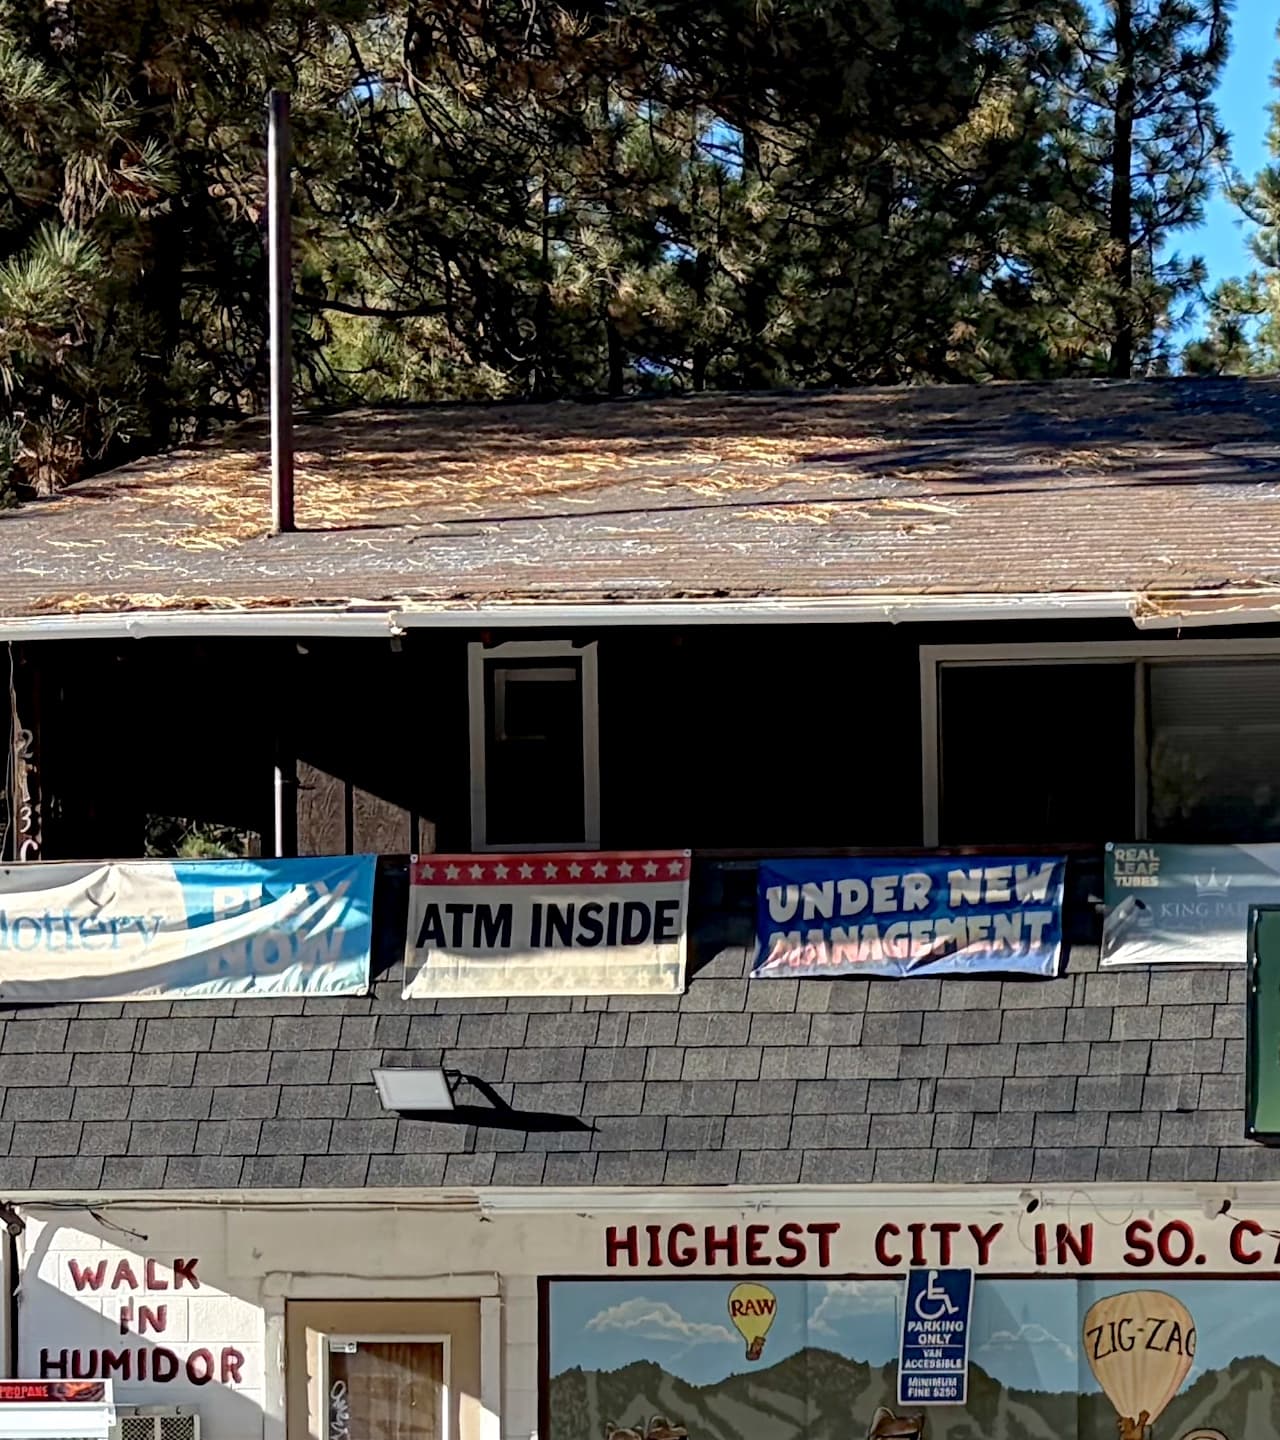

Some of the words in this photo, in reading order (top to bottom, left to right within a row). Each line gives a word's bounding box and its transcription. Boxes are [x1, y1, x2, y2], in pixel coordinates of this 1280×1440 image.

[1115, 848, 1160, 862] REAL
[1114, 863, 1160, 875] LEAF
[1114, 876, 1160, 887] TUBES
[766, 873, 932, 923] UNDER
[948, 862, 1057, 907] NEW
[1161, 902, 1209, 918] KING
[415, 903, 513, 950] ATM
[530, 900, 681, 949] INSIDE
[769, 911, 1053, 967] MANAGEMENT
[206, 927, 346, 974] NOW
[604, 1222, 841, 1268] HIGHEST
[874, 1222, 1004, 1267] CITY
[1034, 1222, 1095, 1268] IN
[1122, 1219, 1206, 1267] SO.
[68, 1258, 200, 1291] WALK
[730, 1296, 777, 1318] RAW
[120, 1297, 167, 1335] IN
[907, 1320, 964, 1333] PARKING
[918, 1333, 952, 1345] ONLY
[923, 1349, 943, 1358] VAN
[40, 1347, 244, 1386] HUMIDOR
[905, 1359, 962, 1369] ACCESSIBLE
[908, 1376, 957, 1387] MINIMUM
[908, 1387, 931, 1397] FINE
